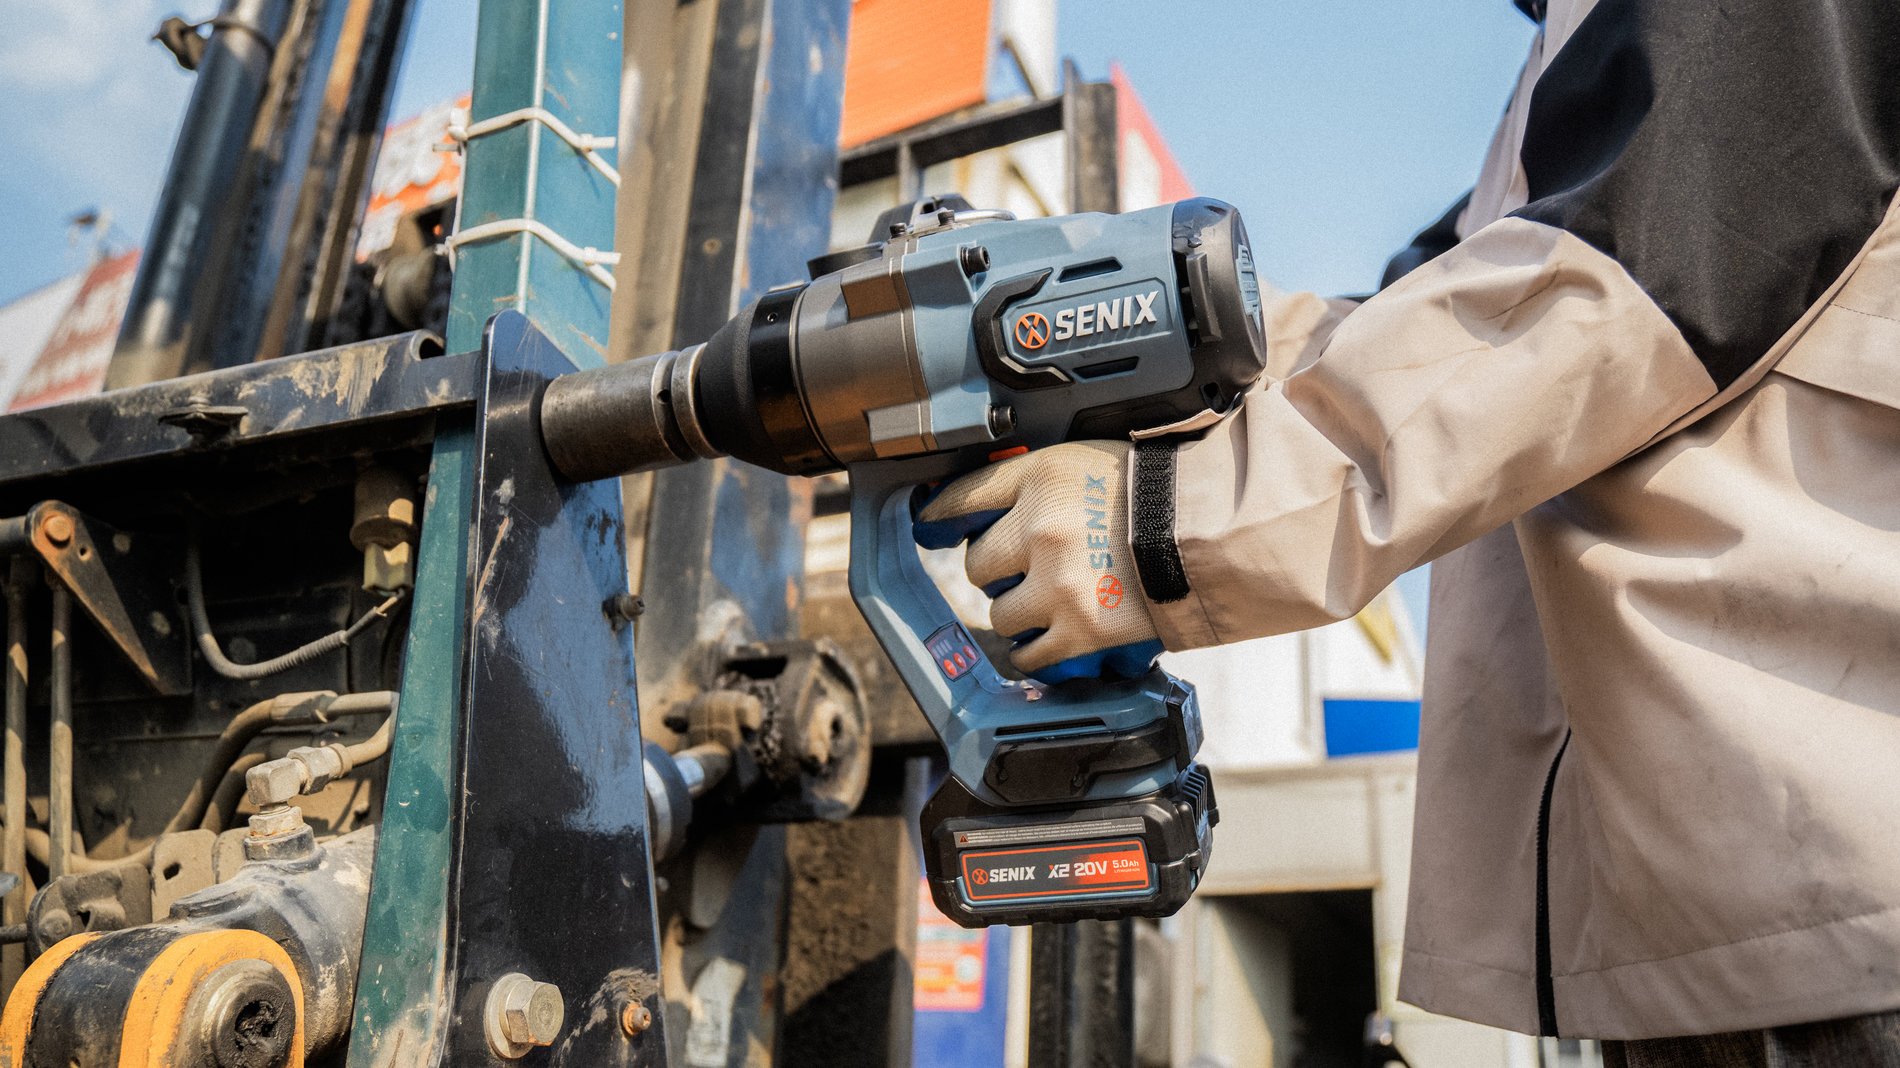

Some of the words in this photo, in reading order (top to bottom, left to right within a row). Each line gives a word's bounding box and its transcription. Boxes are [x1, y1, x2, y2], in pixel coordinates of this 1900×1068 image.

[1055, 291, 1159, 341] SENIX
[1084, 472, 1113, 569] SENIX
[989, 866, 1036, 883] SENIX
[1048, 863, 1070, 879] X2
[1073, 860, 1108, 877] 20V
